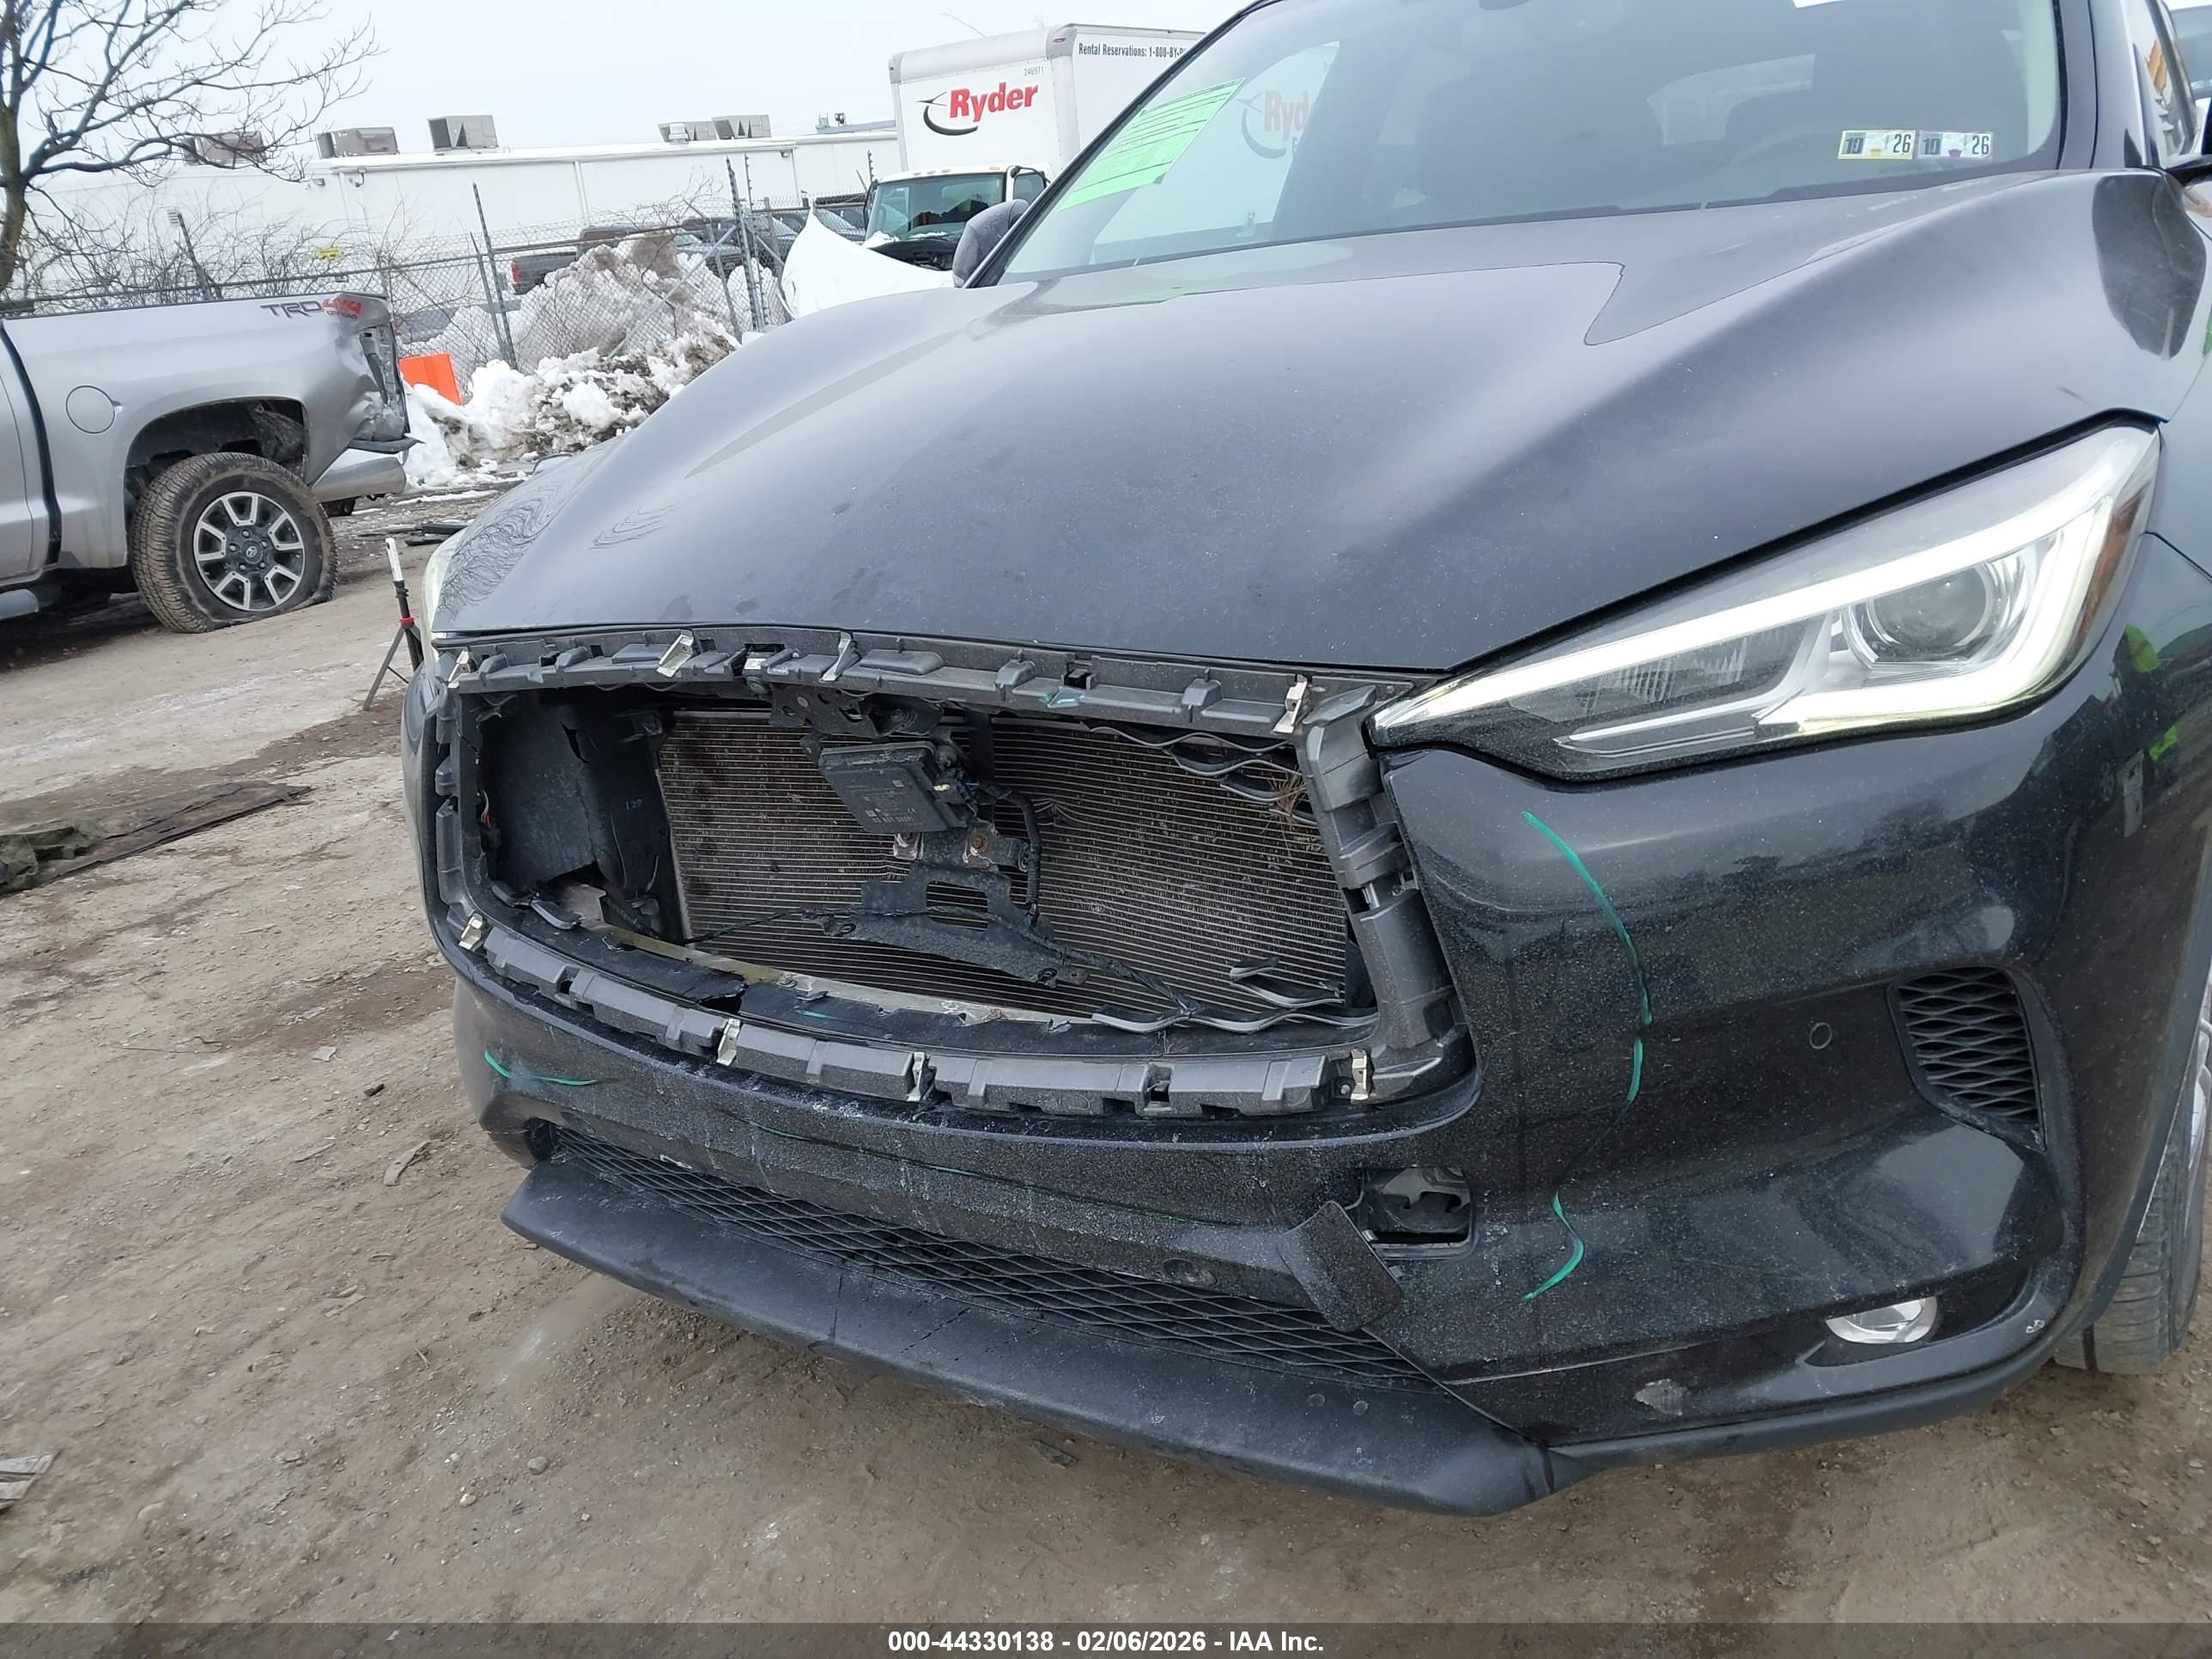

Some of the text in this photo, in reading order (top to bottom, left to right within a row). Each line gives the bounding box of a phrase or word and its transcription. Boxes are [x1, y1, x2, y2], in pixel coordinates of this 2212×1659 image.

[1079, 42, 1101, 56] Rental
[1103, 43, 1147, 58] Reservations:
[950, 82, 1039, 122] Ryder
[1892, 133, 1912, 154] 26
[1972, 134, 1990, 155] 26
[260, 301, 323, 319] TRD
